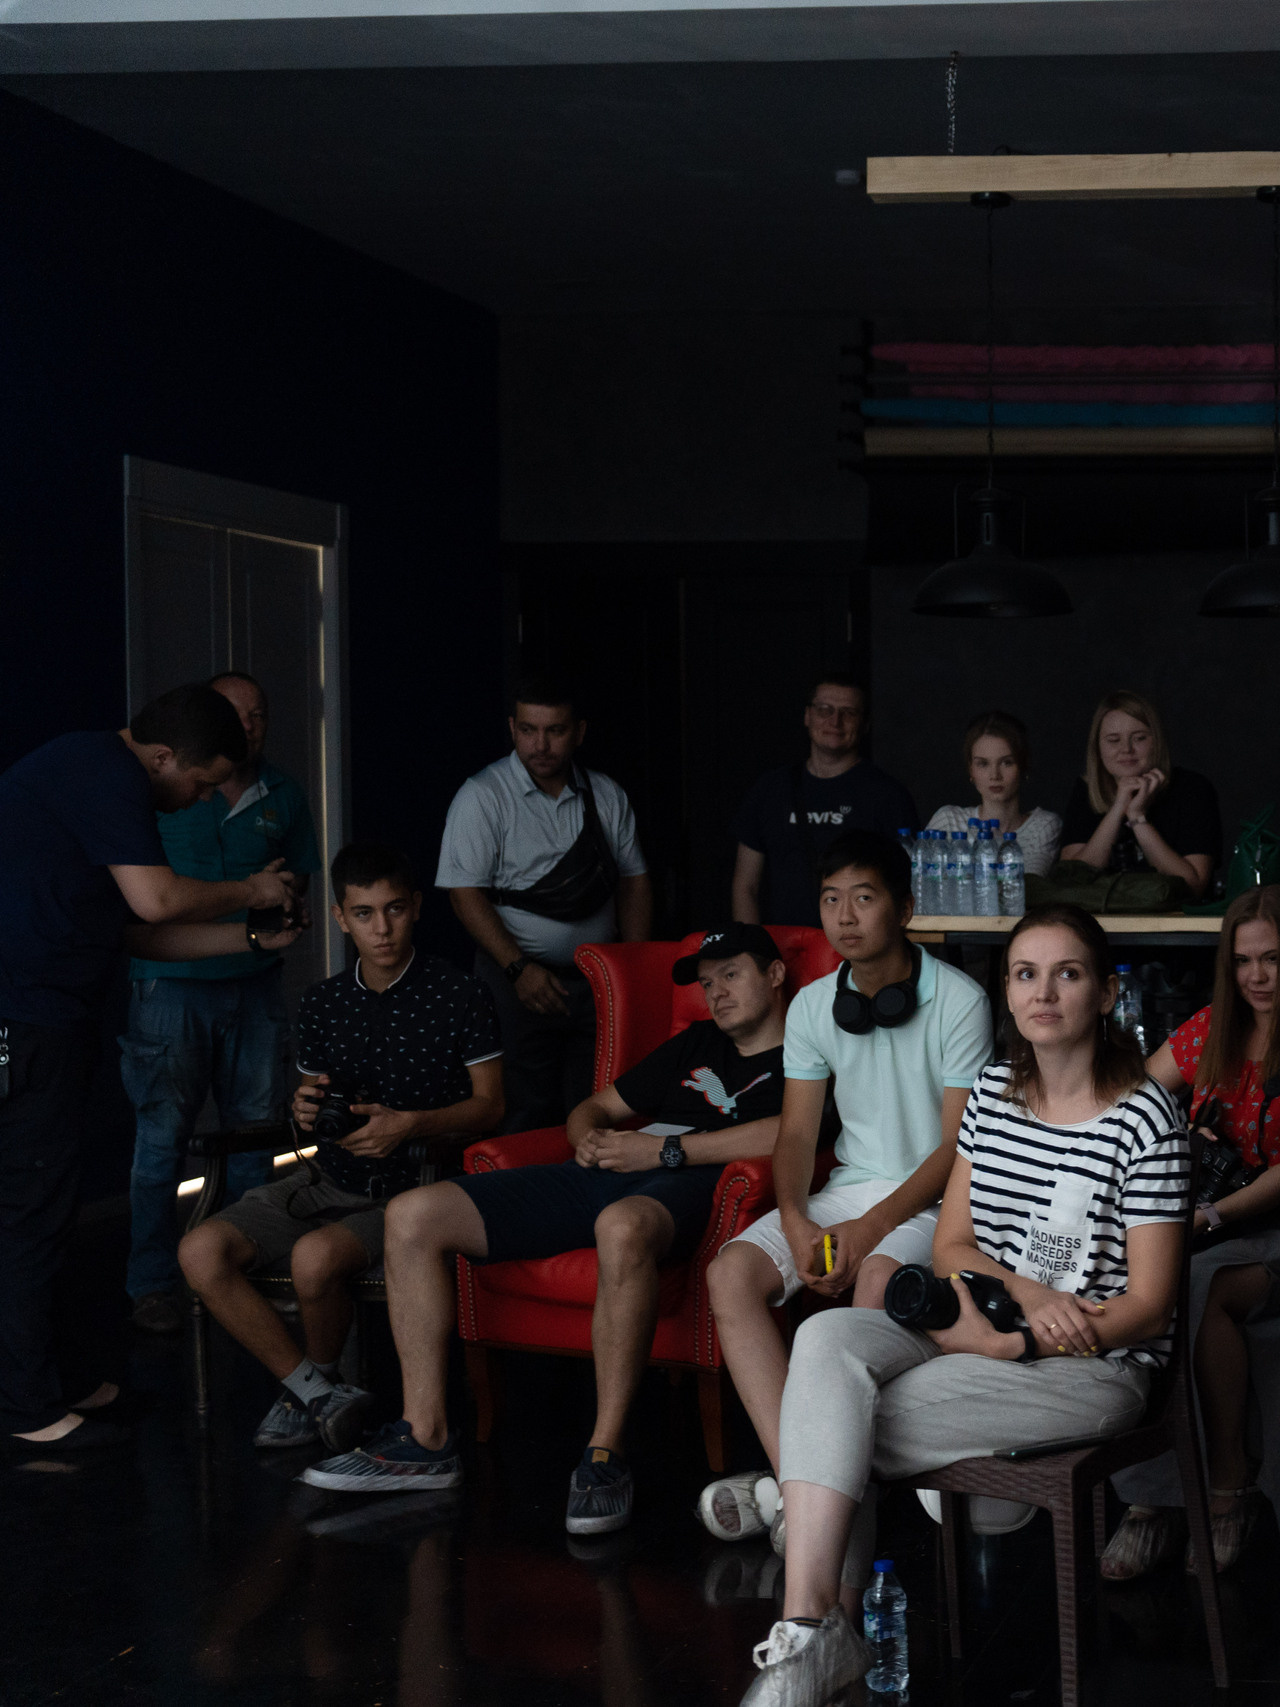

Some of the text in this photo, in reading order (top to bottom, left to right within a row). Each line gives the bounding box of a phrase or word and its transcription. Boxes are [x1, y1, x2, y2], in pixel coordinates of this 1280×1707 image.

[1030, 1225, 1081, 1249] MADNESS
[1030, 1239, 1072, 1260] BREEDS
[1026, 1250, 1078, 1273] MADNESS
